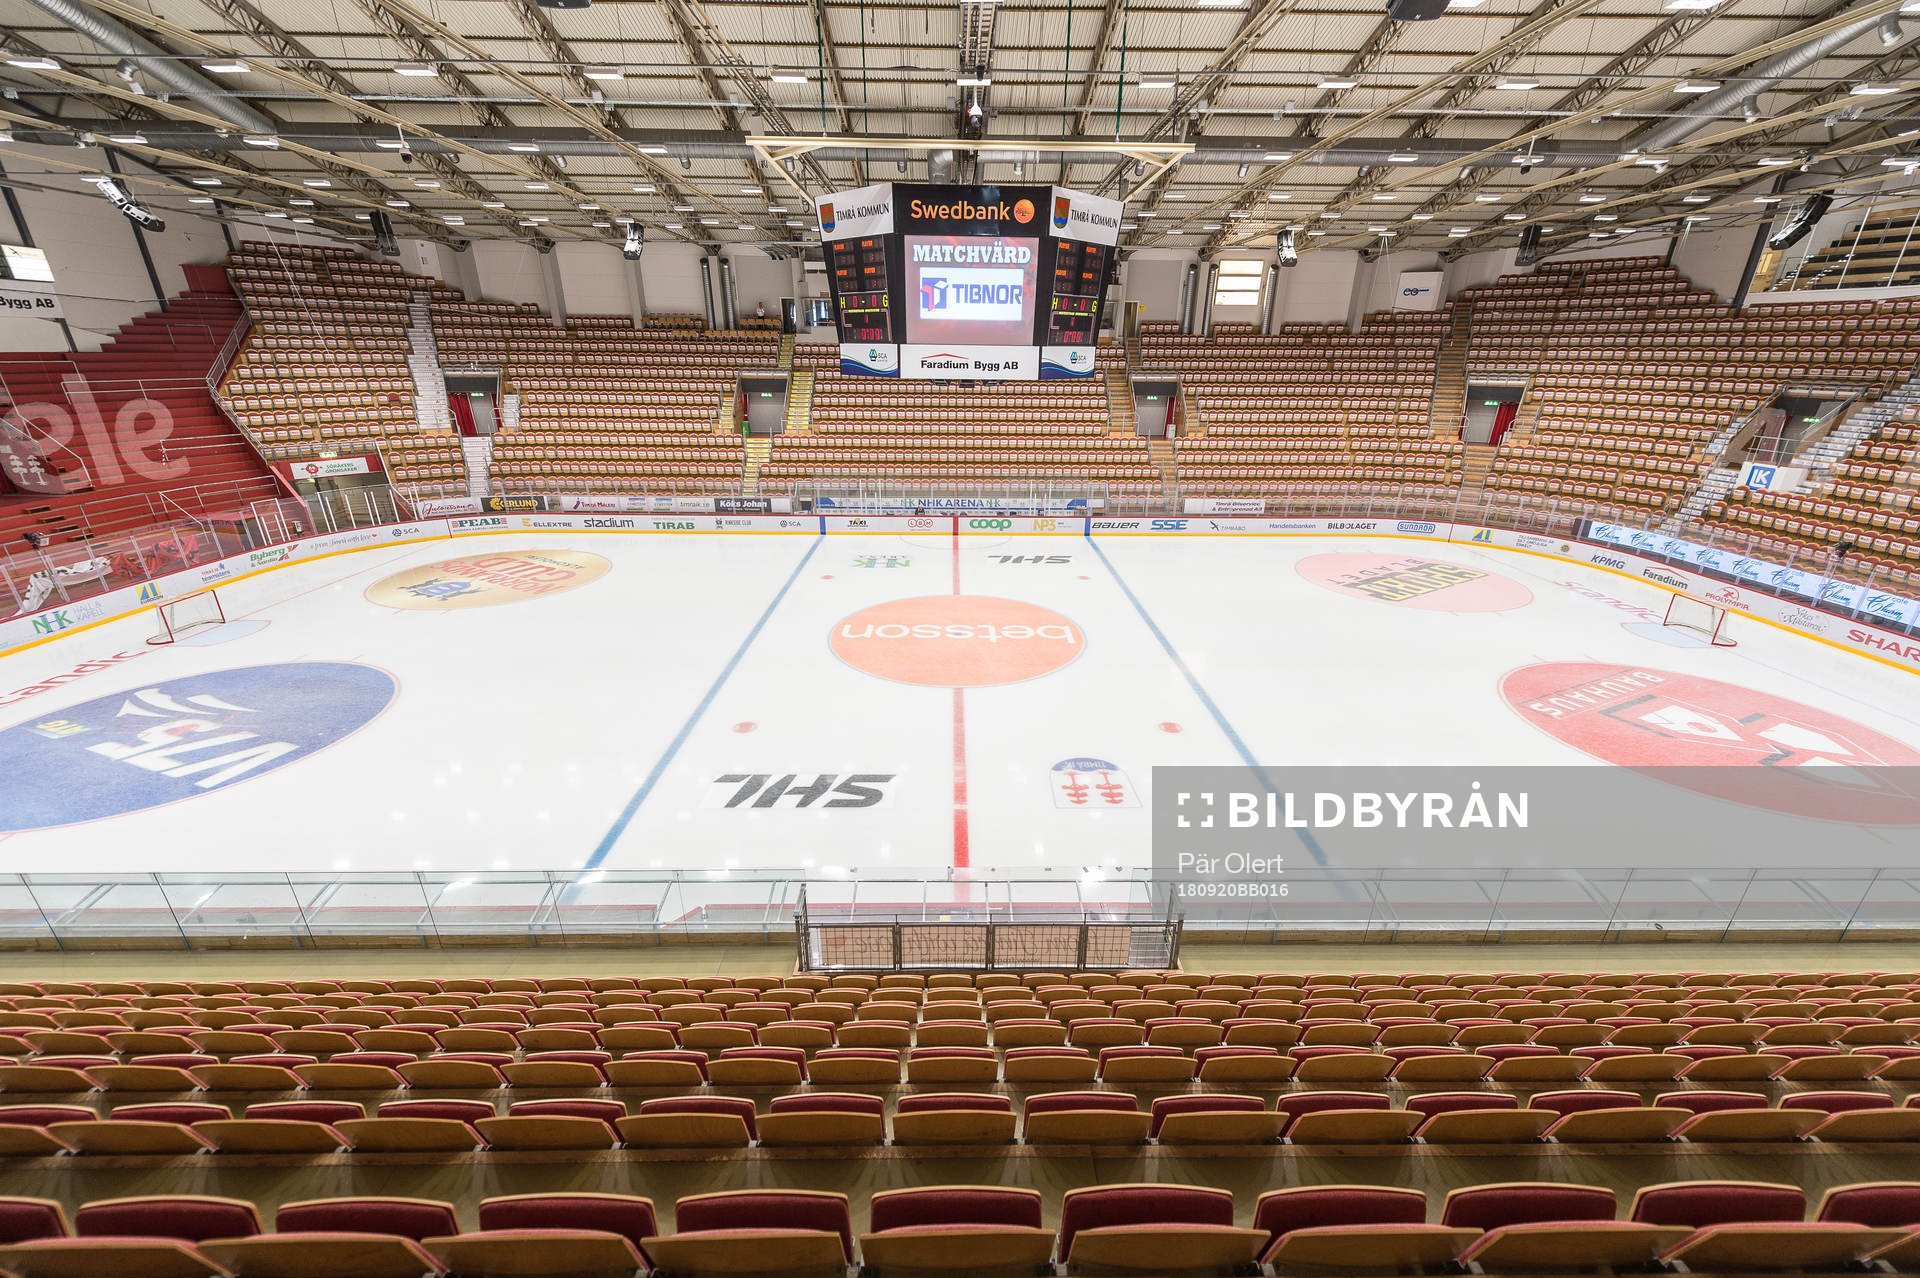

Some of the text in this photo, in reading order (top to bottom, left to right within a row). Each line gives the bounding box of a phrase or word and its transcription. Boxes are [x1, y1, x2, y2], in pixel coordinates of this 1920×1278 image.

[836, 202, 890, 222] TIMRÅ KOMMUN
[910, 200, 1010, 220] Swedbank
[1070, 209, 1118, 229] TIMRÅ KOMMUN
[913, 242, 1031, 264] MATCHVÄRD
[36, 298, 55, 308] AB
[840, 296, 846, 308] H
[882, 294, 888, 307] G
[952, 284, 1022, 304] TIBNOR
[1052, 298, 1058, 309] H
[1092, 300, 1098, 312] G
[920, 360, 1019, 372] Faradium Bygg AB
[720, 500, 741, 508] Köks
[459, 517, 501, 528] PEAB
[584, 518, 634, 528] stadium
[970, 519, 1012, 531] coop
[1033, 519, 1056, 531] NP3
[1151, 520, 1189, 530] SSE
[250, 547, 285, 562] Byberg
[987, 555, 1073, 564] SHL
[1590, 554, 1625, 570] KPMG
[472, 557, 576, 582] GULD
[1328, 558, 1424, 585] BLADET
[1642, 568, 1688, 590] Faradium
[1350, 564, 1488, 601] SPORT
[1704, 592, 1750, 611] PROLYMPIA
[842, 624, 1076, 644] betsson
[1847, 629, 1920, 662] SHAR
[1530, 671, 1664, 718] BAUHAUS
[713, 774, 896, 808] SHL
